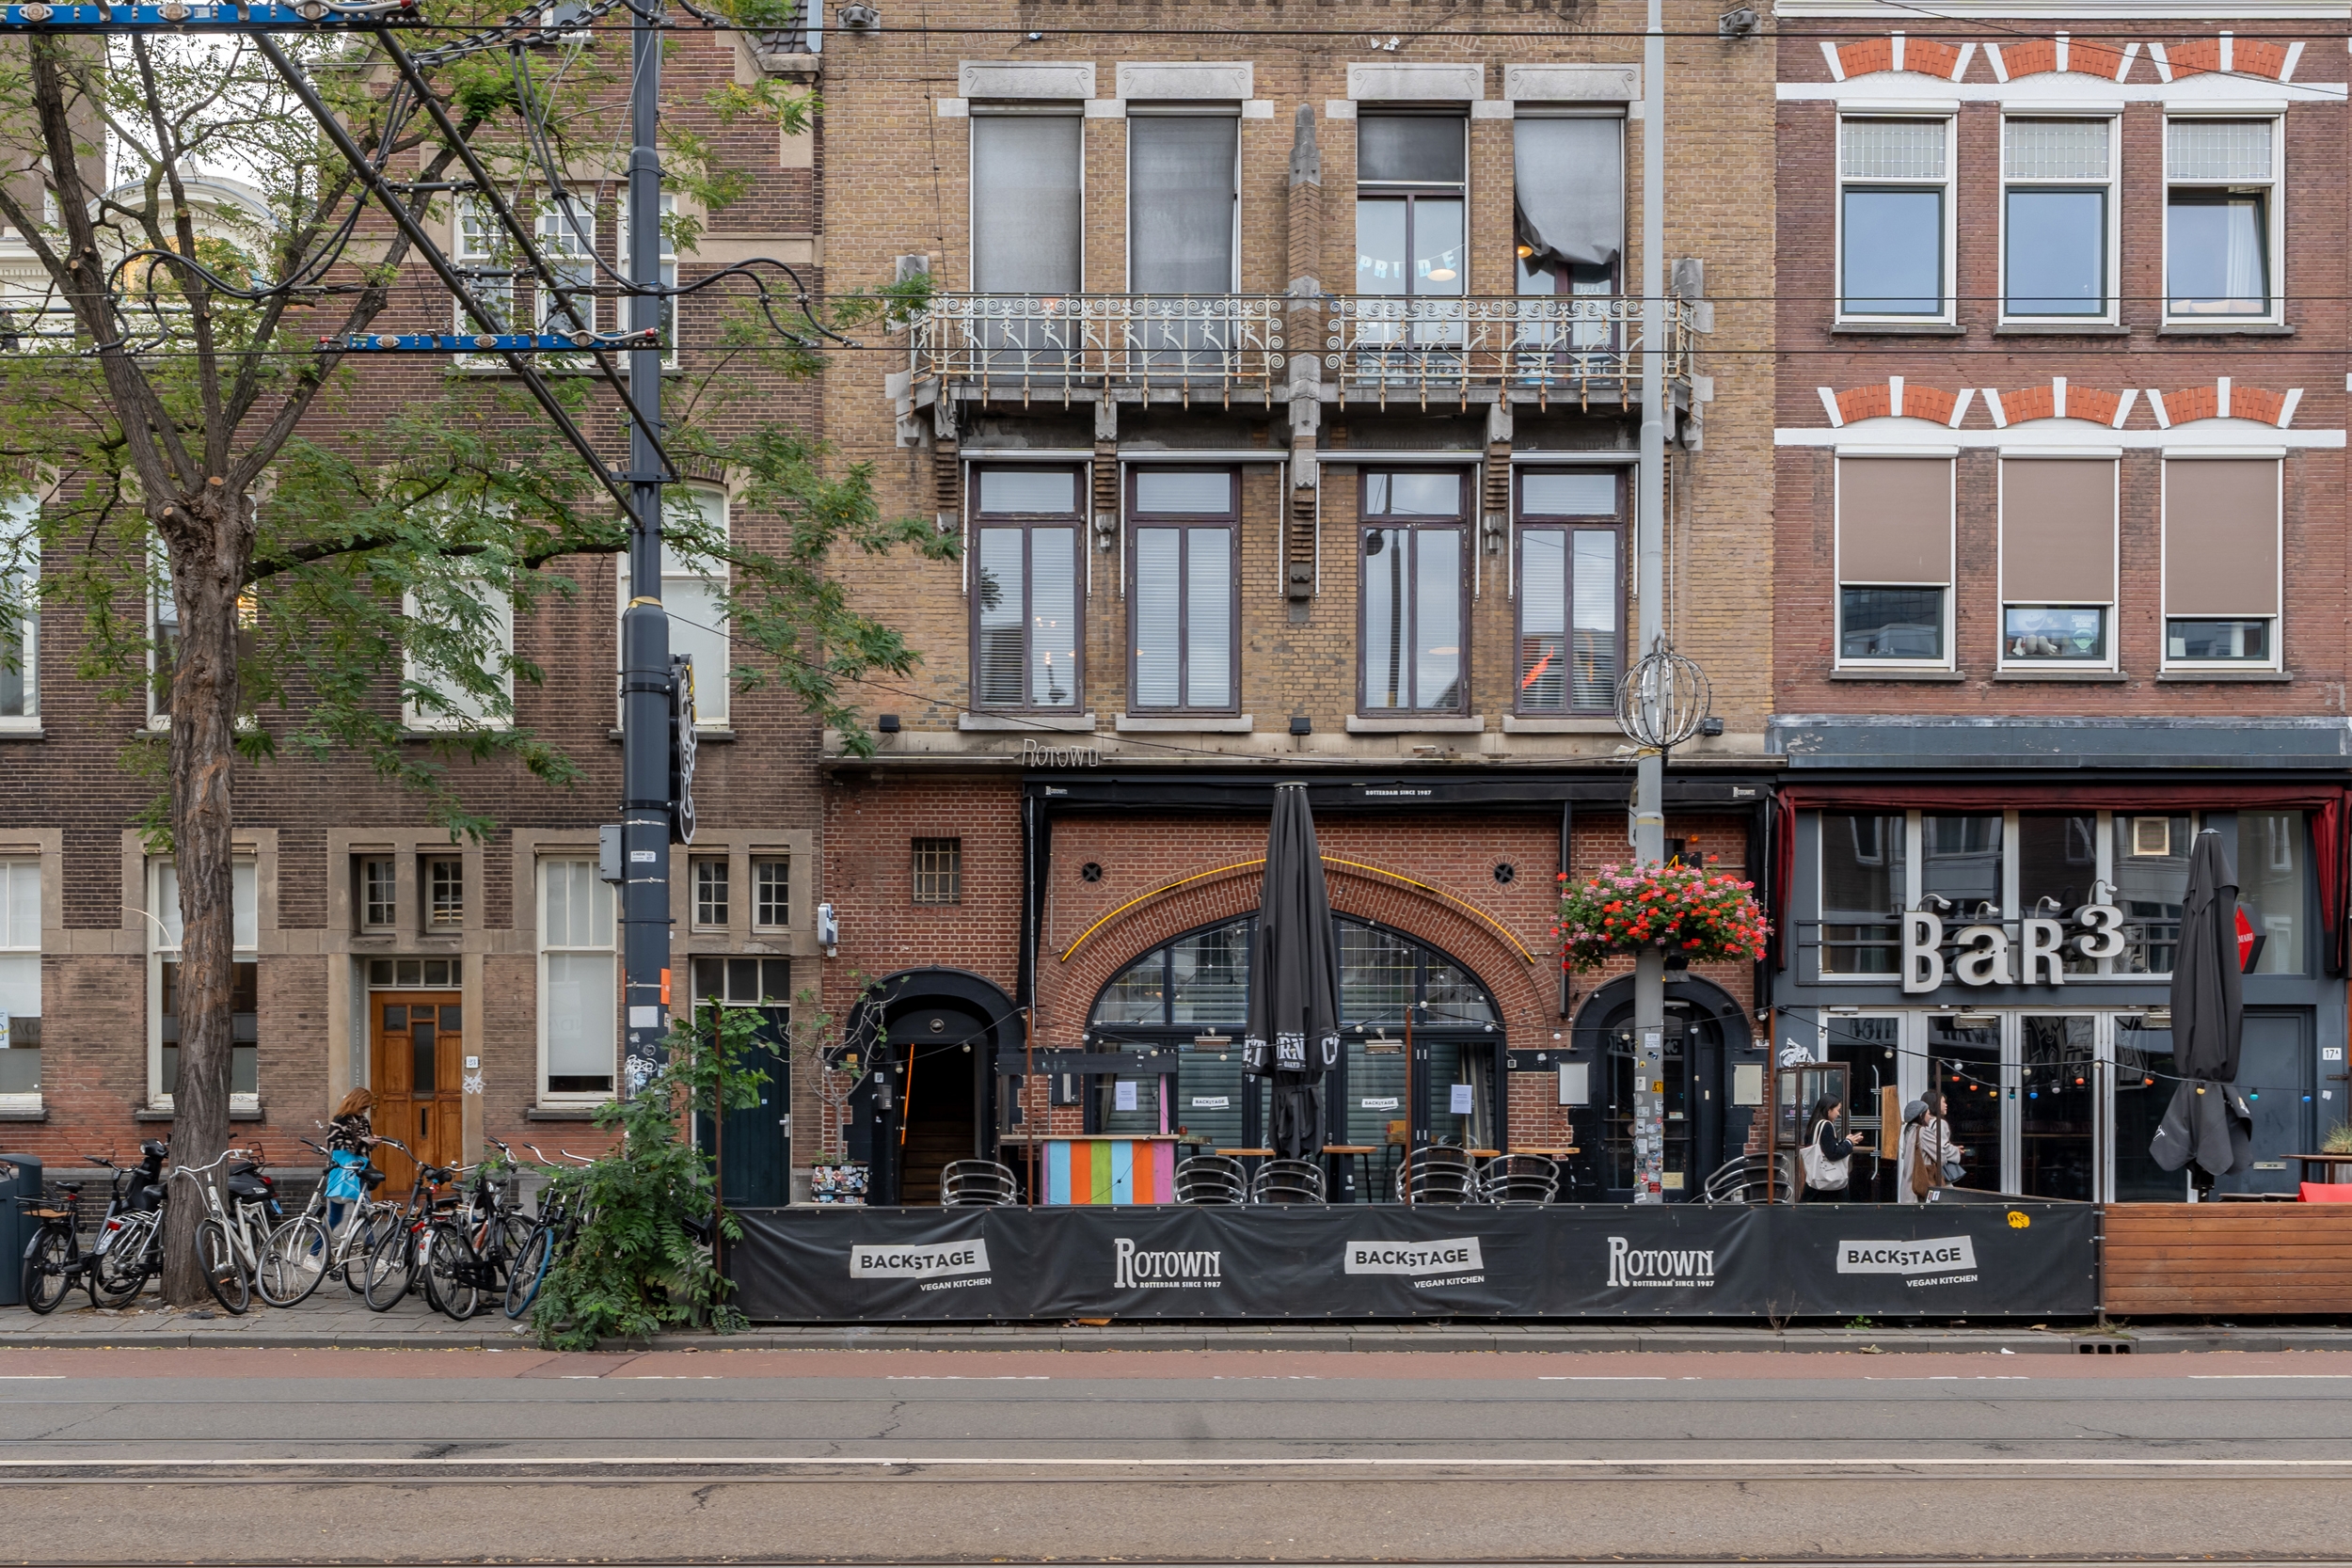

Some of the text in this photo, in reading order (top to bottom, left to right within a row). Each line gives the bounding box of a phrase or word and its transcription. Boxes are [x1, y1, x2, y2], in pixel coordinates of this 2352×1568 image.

[1358, 250, 1457, 278] PRIDE
[861, 1250, 975, 1271] BACKSTAGE
[1356, 1248, 1469, 1267] BACKSTAGE
[1848, 1247, 1962, 1266] BACKSTAGE
[920, 1277, 992, 1291] VEGAN KITCHEN
[1414, 1275, 1485, 1289] VEGAN KITCHEN
[1906, 1275, 1978, 1288] VEGAN KITCHEN
